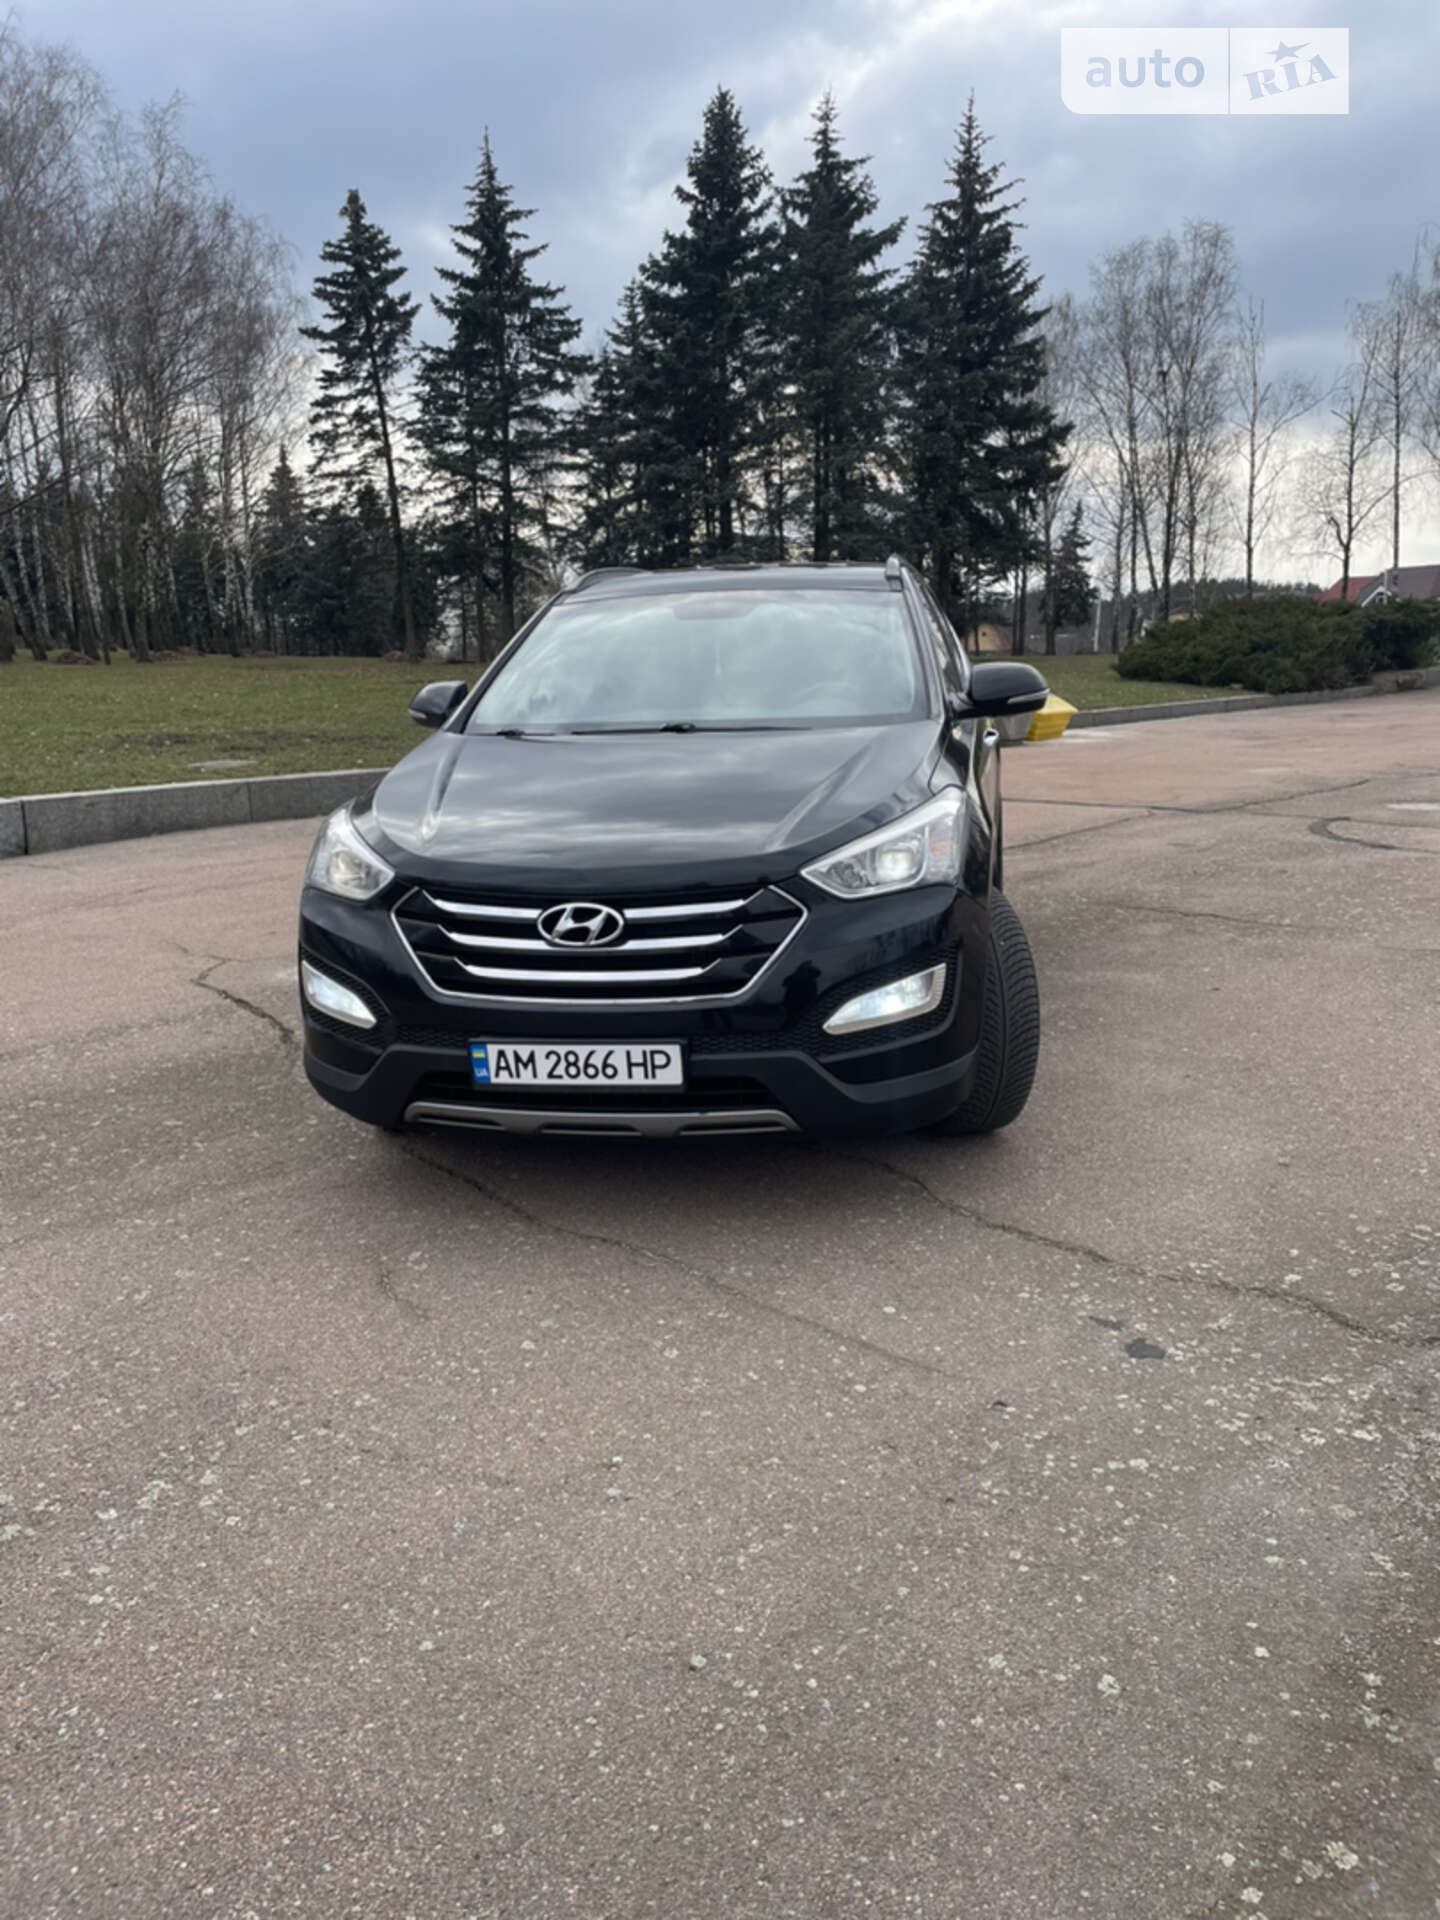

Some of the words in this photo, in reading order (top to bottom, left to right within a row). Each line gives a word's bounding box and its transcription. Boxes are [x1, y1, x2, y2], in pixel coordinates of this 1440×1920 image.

[474, 1069, 489, 1078] UA
[494, 1049, 538, 1079] AM
[545, 1050, 618, 1080] 2866
[626, 1050, 671, 1080] HP
